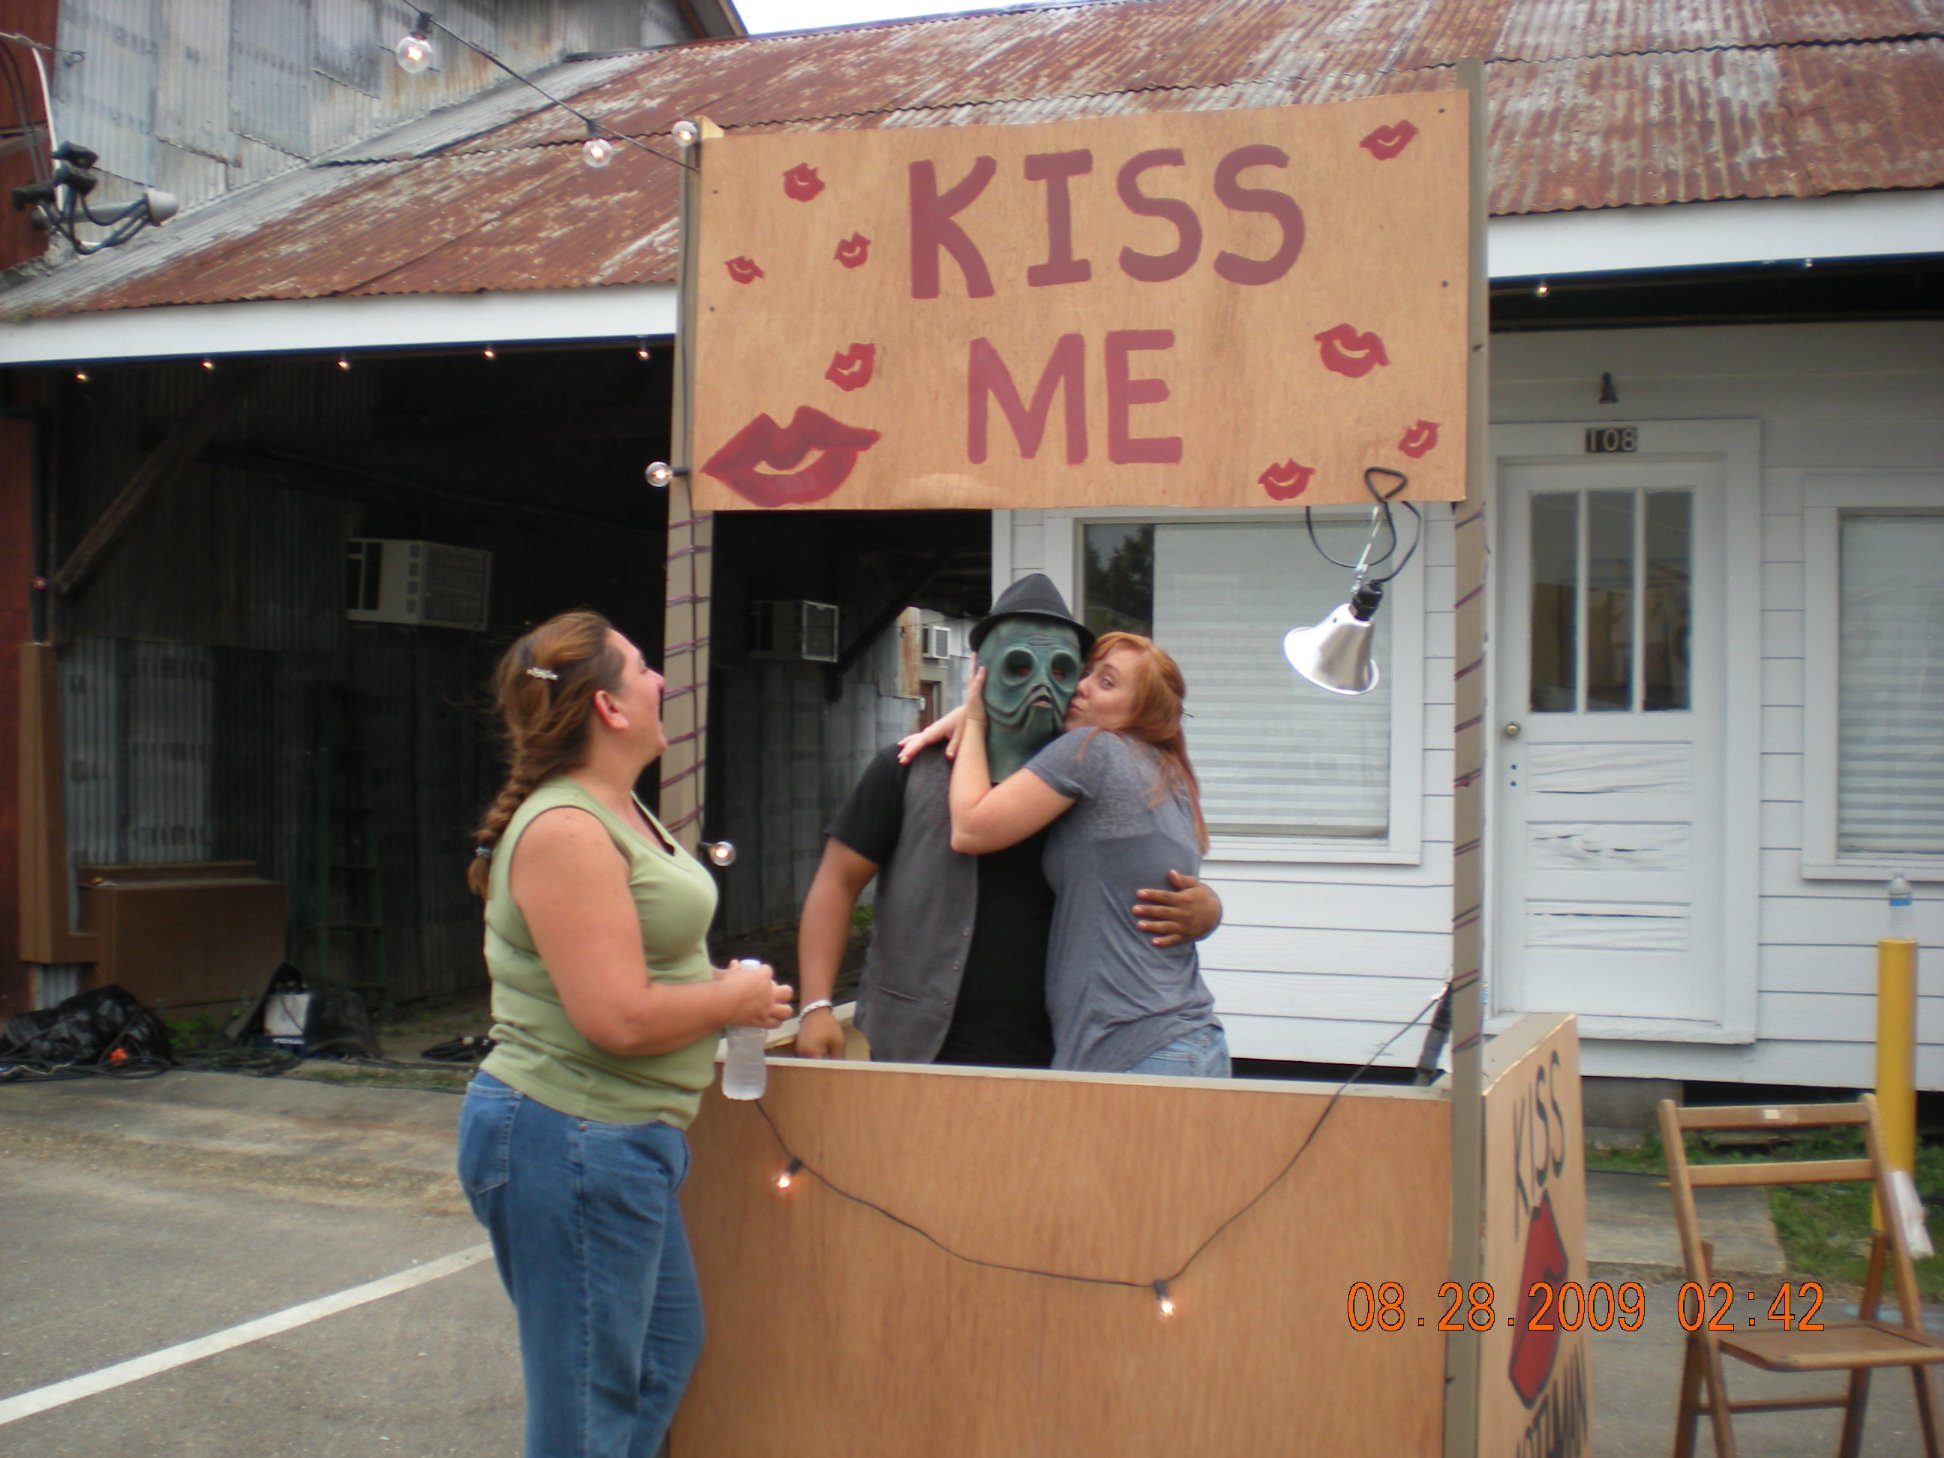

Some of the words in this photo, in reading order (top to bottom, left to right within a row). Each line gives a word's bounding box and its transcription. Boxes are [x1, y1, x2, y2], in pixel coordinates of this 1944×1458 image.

[909, 144, 1305, 300] KISS
[967, 328, 1184, 466] ME
[1590, 427, 1636, 453] 108
[1512, 1050, 1566, 1242] KISS
